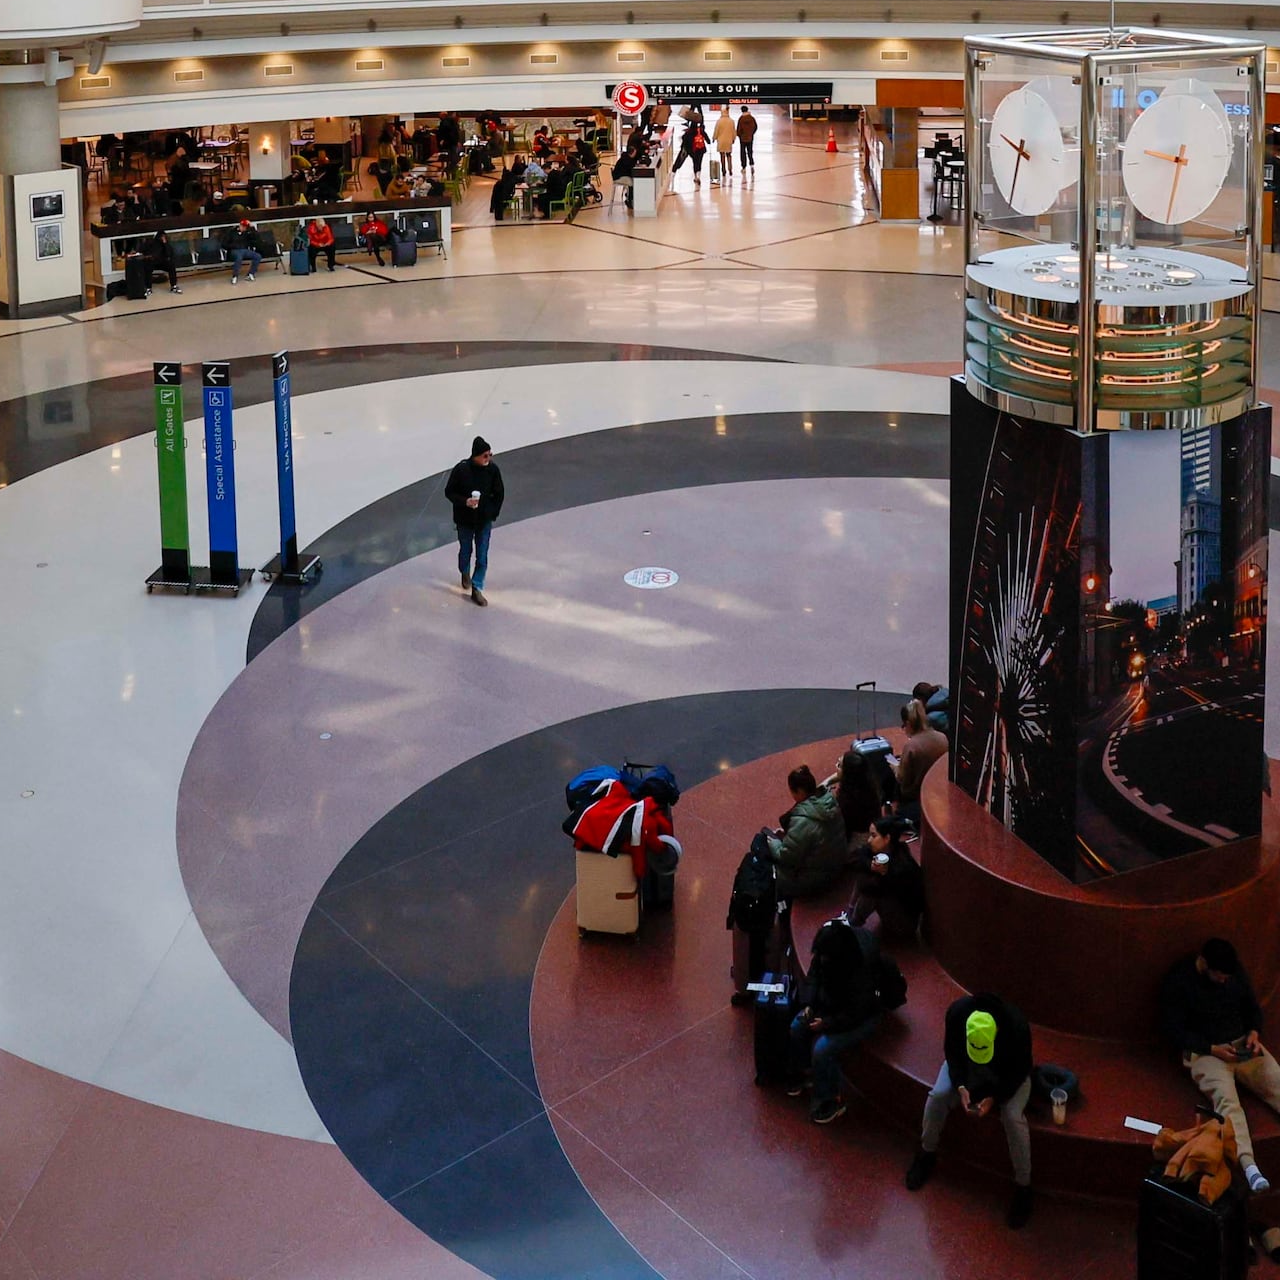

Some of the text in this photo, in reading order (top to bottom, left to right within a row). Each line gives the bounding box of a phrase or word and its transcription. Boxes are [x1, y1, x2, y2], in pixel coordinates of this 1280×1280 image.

[624, 87, 640, 108] S
[650, 84, 759, 94] TERMINAL SOUTH
[165, 407, 174, 452] All Gates
[213, 409, 225, 501] Special Assistance
